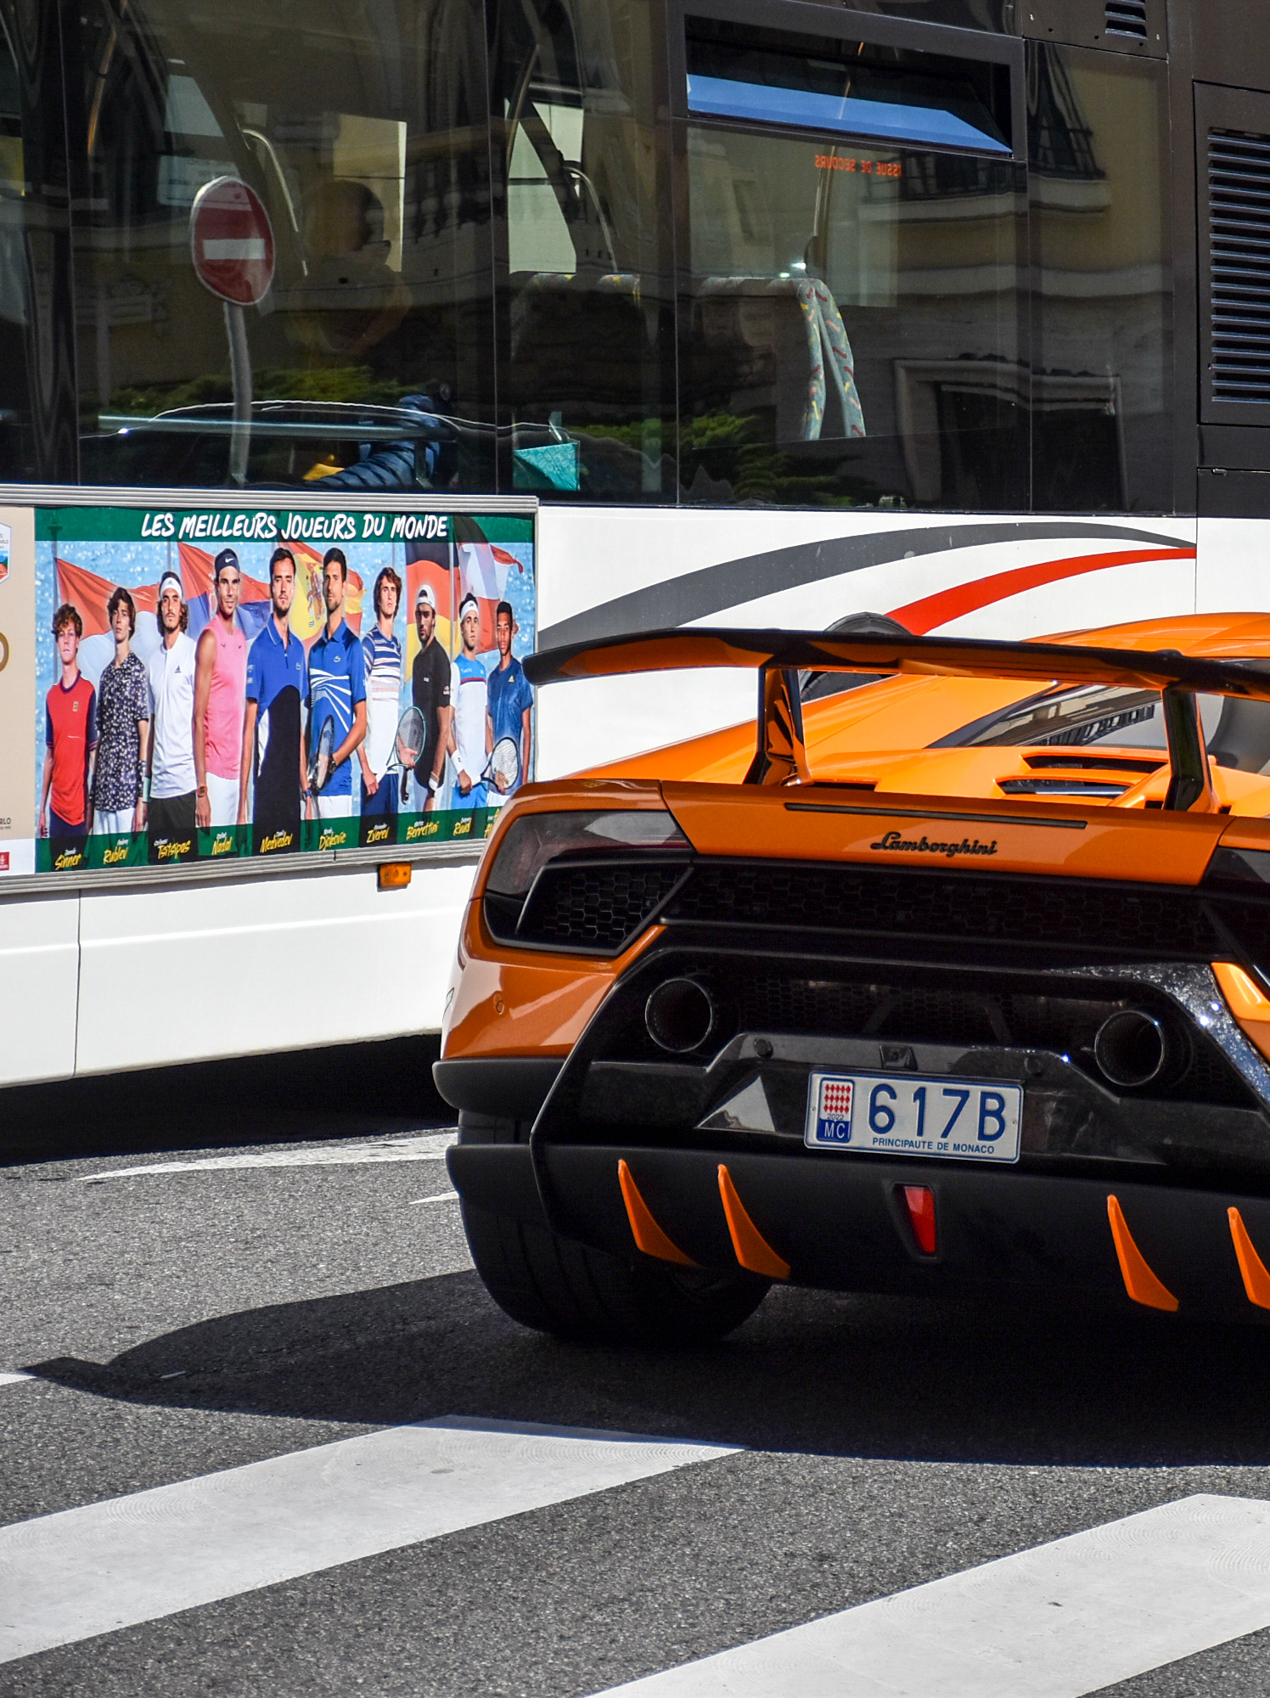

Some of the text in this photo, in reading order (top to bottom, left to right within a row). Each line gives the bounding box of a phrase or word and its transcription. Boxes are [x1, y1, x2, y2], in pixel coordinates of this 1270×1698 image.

[141, 512, 448, 540] LES MEILLEURS JOUEURS DU MONDE
[870, 831, 998, 858] Lamborghini
[868, 1083, 1006, 1142] 617B
[824, 1122, 845, 1140] MC
[872, 1137, 995, 1154] PRINCIPAUTE DE MONACO
